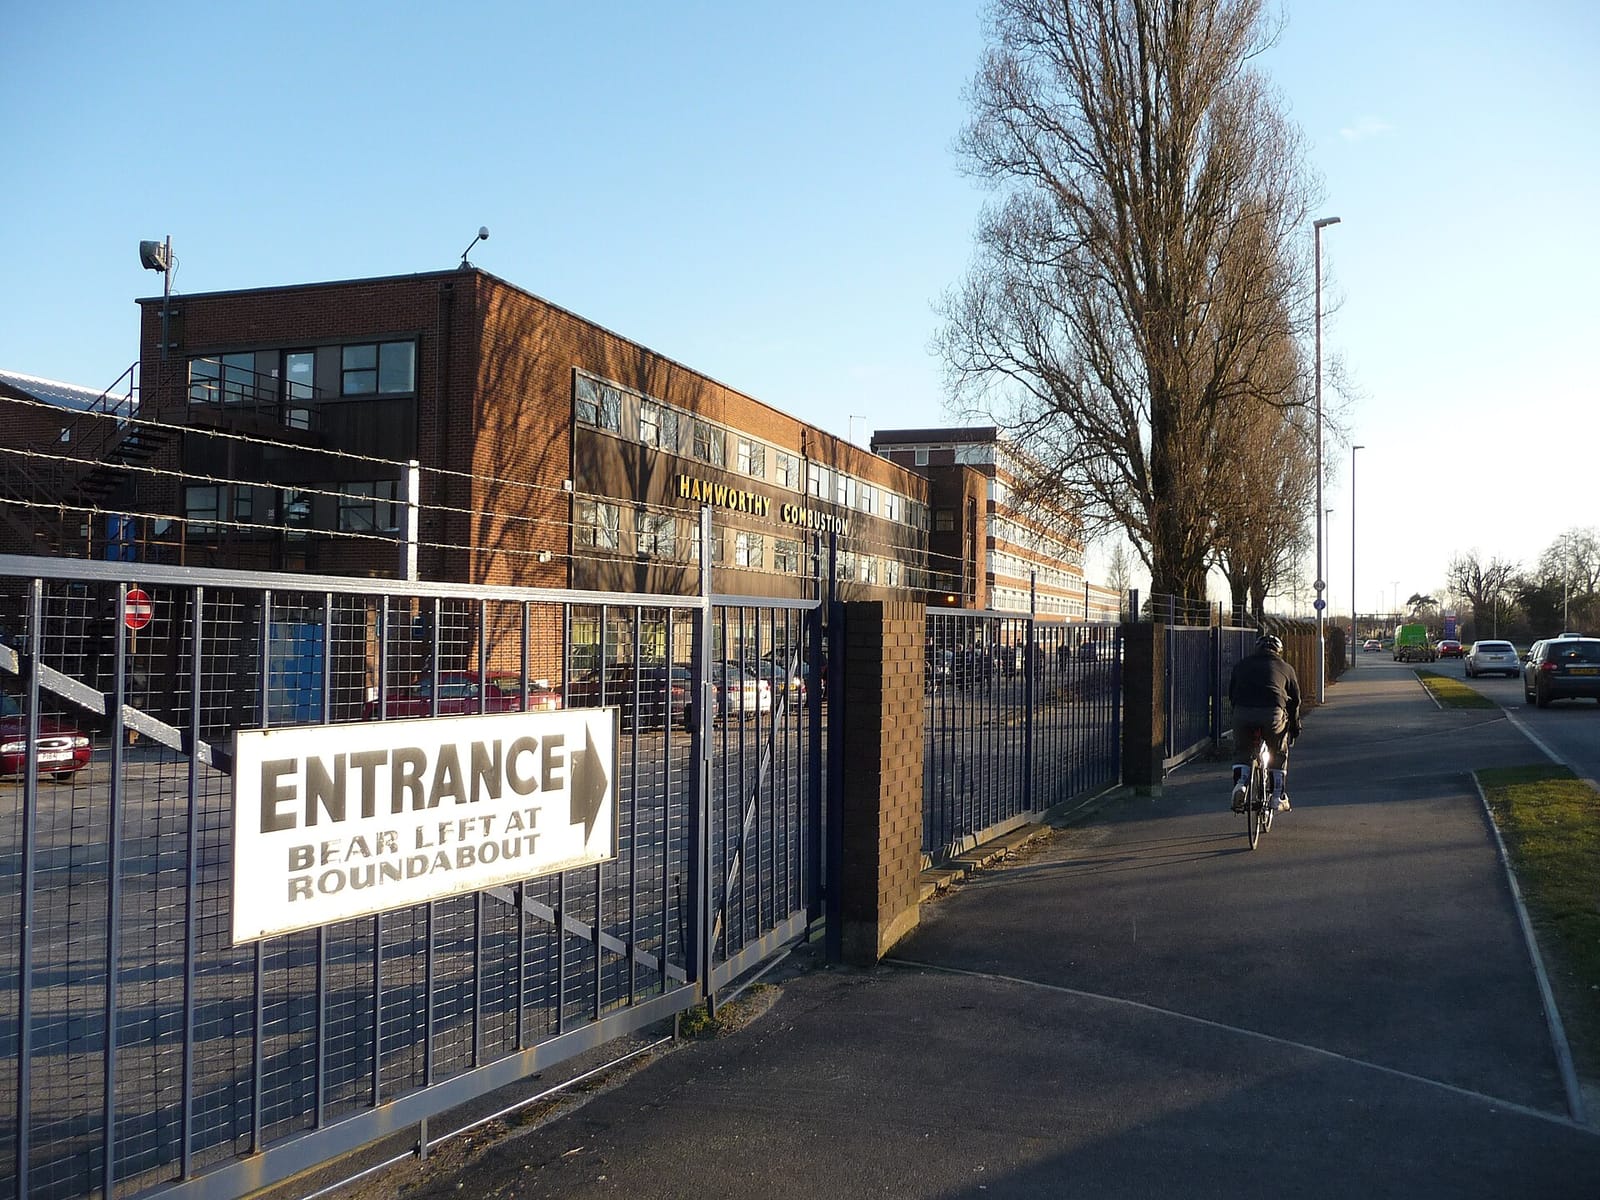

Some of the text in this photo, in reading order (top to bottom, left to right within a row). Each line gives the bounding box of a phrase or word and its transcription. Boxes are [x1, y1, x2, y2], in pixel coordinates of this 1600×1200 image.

[680, 474, 848, 536] HAMWORTHY COMBUSTION
[260, 734, 565, 834] ENTRANCE
[287, 833, 542, 903] ROUNDABOUT
[288, 830, 399, 873] BEAR
[504, 806, 543, 834] AT
